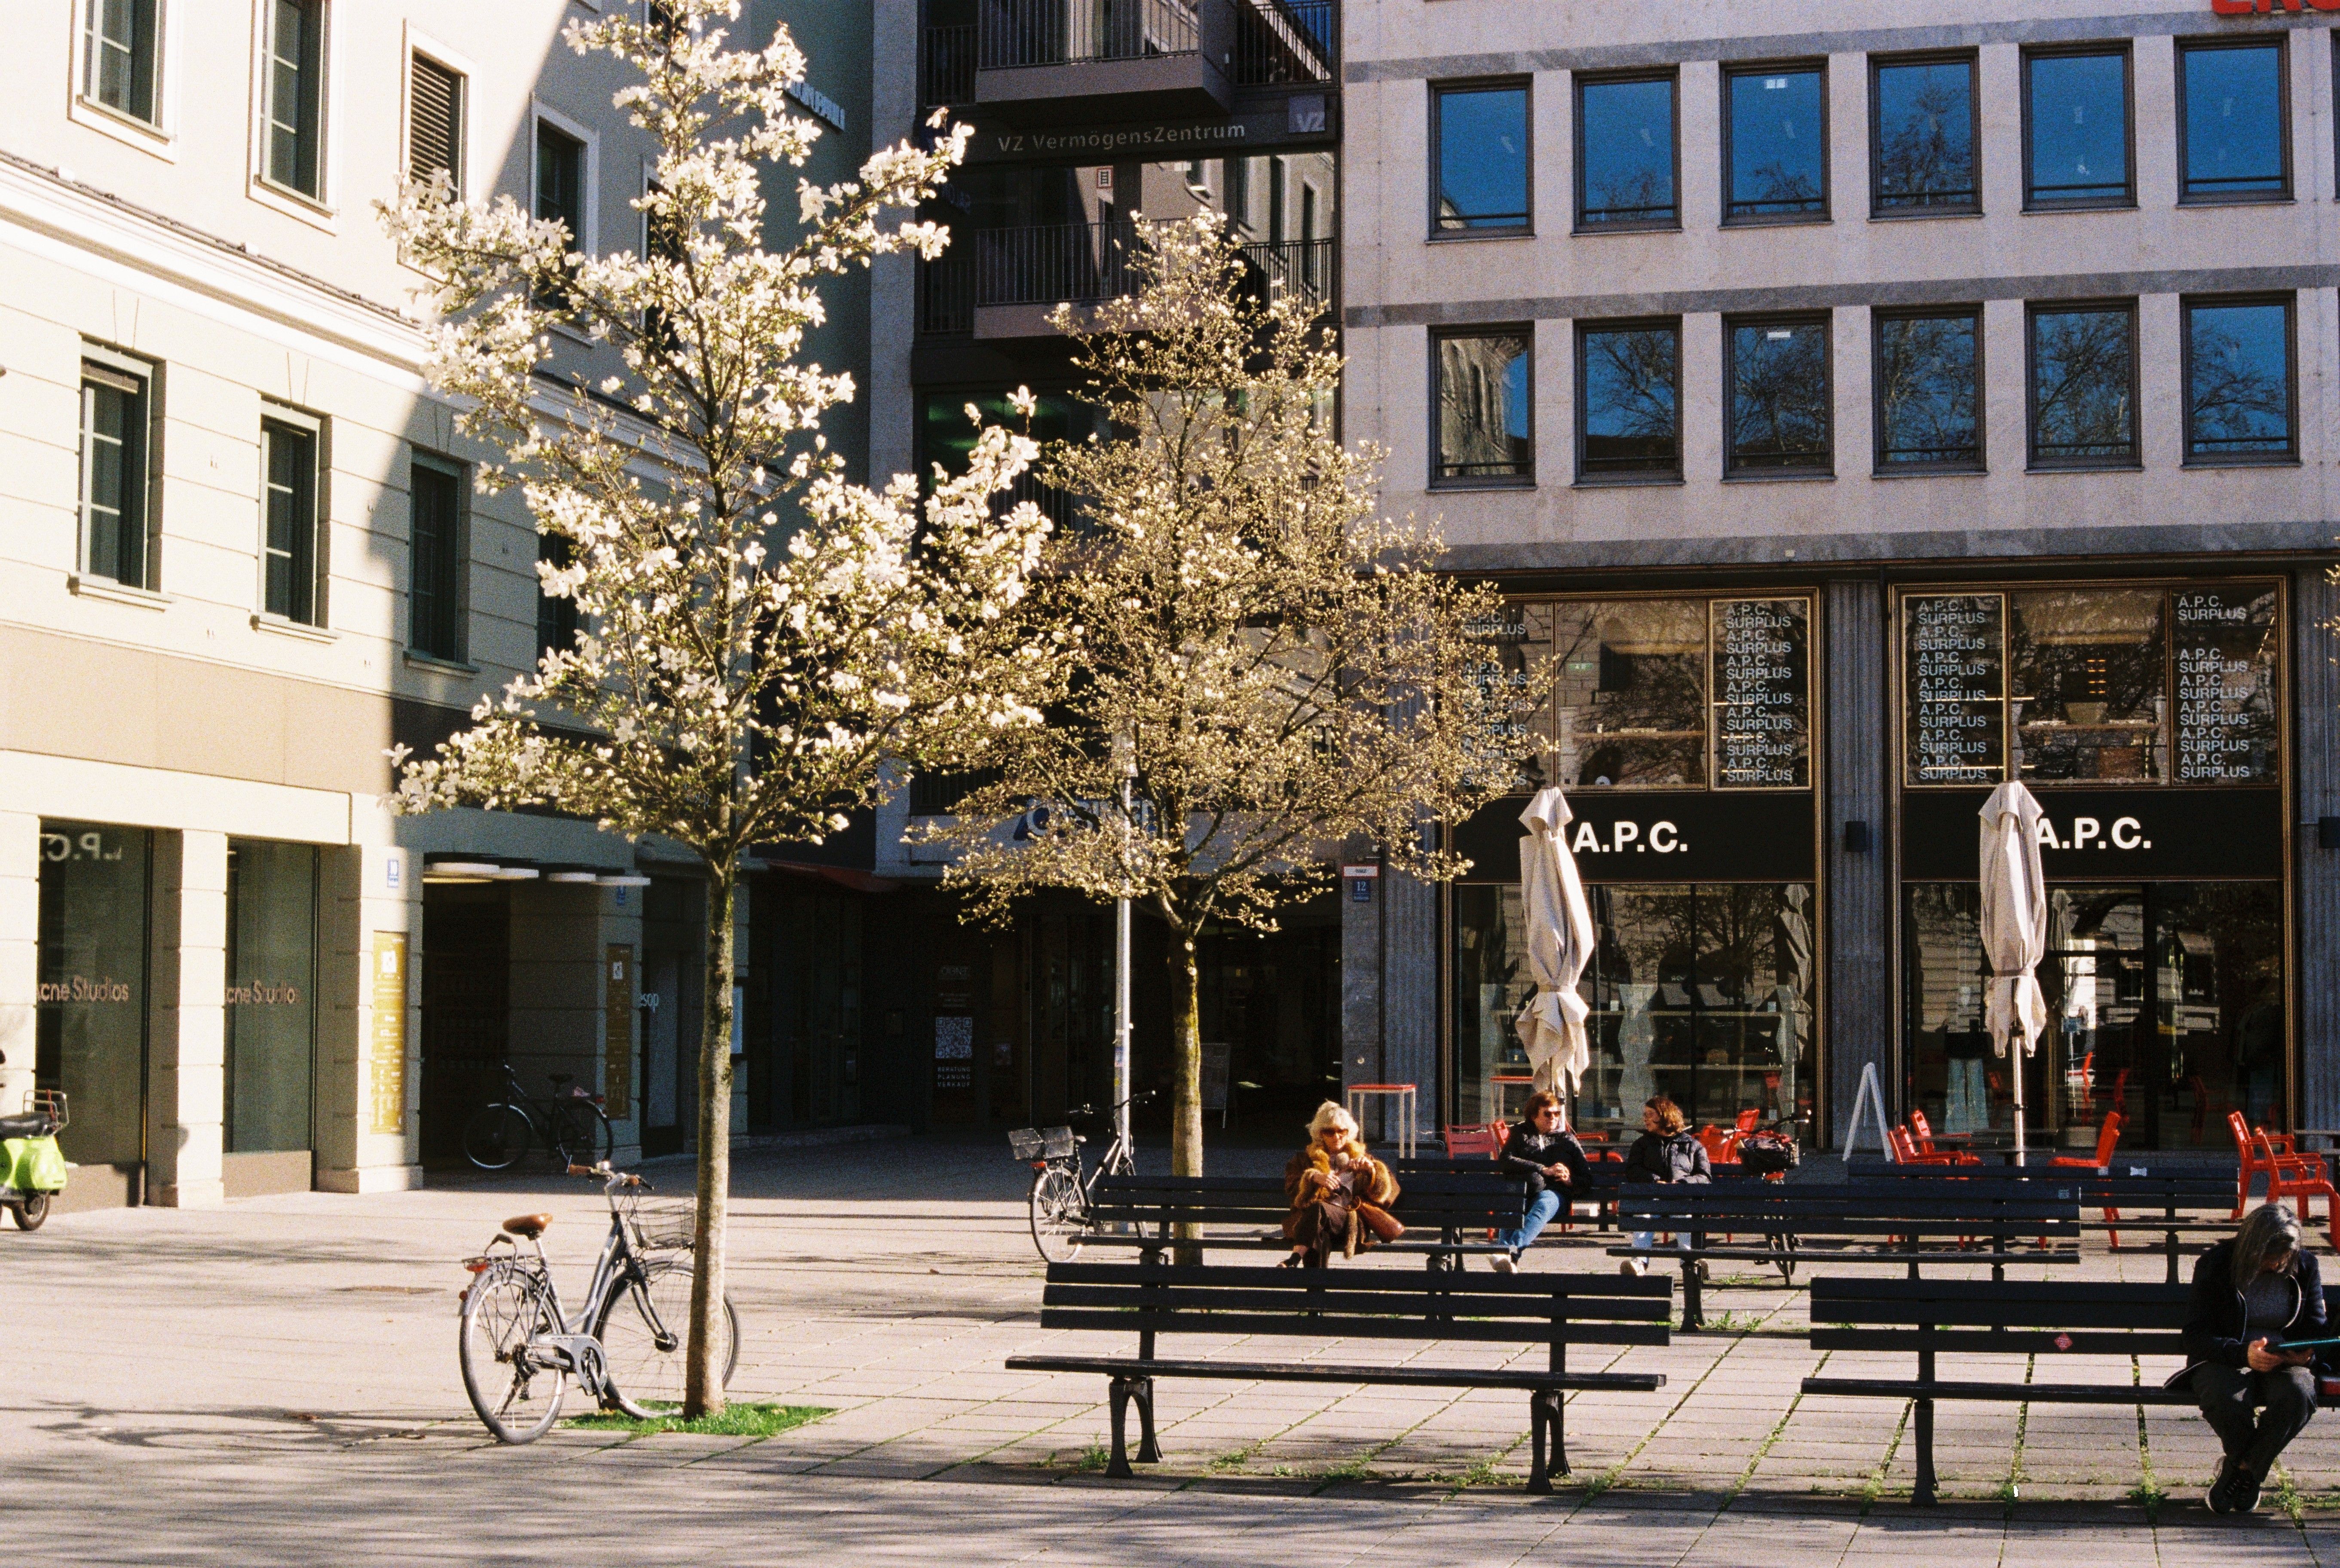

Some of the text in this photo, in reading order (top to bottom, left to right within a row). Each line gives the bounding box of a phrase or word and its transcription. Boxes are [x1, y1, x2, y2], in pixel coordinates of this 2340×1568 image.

[1297, 110, 1325, 132] VZ
[998, 125, 1244, 151] VZ VermögensZentrum
[1919, 600, 1963, 612] A.P.C.
[2178, 596, 2223, 608] A.P.C.
[1727, 604, 1770, 616] A.P.C.
[2178, 607, 2246, 620] SURPLUS
[1726, 616, 1792, 629] SURPLUS
[1919, 612, 1985, 624] SURPLUS
[1726, 630, 1769, 641] A.P.C.
[1919, 626, 1963, 638] A.P.C.
[1726, 642, 1792, 654] SURPLUS
[1919, 638, 1985, 650] SURPLUS
[1727, 654, 1770, 666] A.P.C.
[1920, 651, 1963, 663] A.P.C.
[2179, 648, 2224, 660] A.P.C.
[1919, 664, 1986, 676] SURPLUS
[2179, 660, 2247, 673] SURPLUS
[1726, 667, 1792, 679] SURPLUS
[1727, 681, 1770, 692] A.P.C.
[1919, 677, 1963, 690] A.P.C.
[2180, 674, 2225, 687] A.P.C.
[1726, 693, 1792, 705] SURPLUS
[1919, 690, 1986, 702] SURPLUS
[2180, 687, 2248, 699] SURPLUS
[1727, 706, 1770, 718] A.P.C.
[1920, 703, 1964, 715] A.P.C.
[2180, 700, 2224, 712] A.P.C.
[1727, 718, 1792, 730] SURPLUS
[1920, 715, 1986, 727] SURPLUS
[2180, 713, 2248, 725] SURPLUS
[1727, 731, 1770, 743] A.P.C.
[1920, 729, 1964, 741] A.P.C.
[2181, 727, 2225, 739] A.P.C.
[1727, 744, 1792, 756] SURPLUS
[1920, 742, 1986, 753] SURPLUS
[2181, 740, 2249, 752] SURPLUS
[1727, 757, 1770, 769] A.P.C.
[1920, 755, 1964, 767] A.P.C.
[2181, 753, 2226, 765] A.P.C.
[1727, 769, 1793, 782] SURPLUS
[1920, 768, 1987, 779] SURPLUS
[2181, 766, 2250, 778] SURPLUS
[1572, 821, 1688, 853] A.P.C.
[2036, 817, 2151, 850] A.P.C.
[1357, 881, 1366, 891] 12
[37, 975, 129, 1002] cne Studios
[225, 987, 251, 1004] cne
